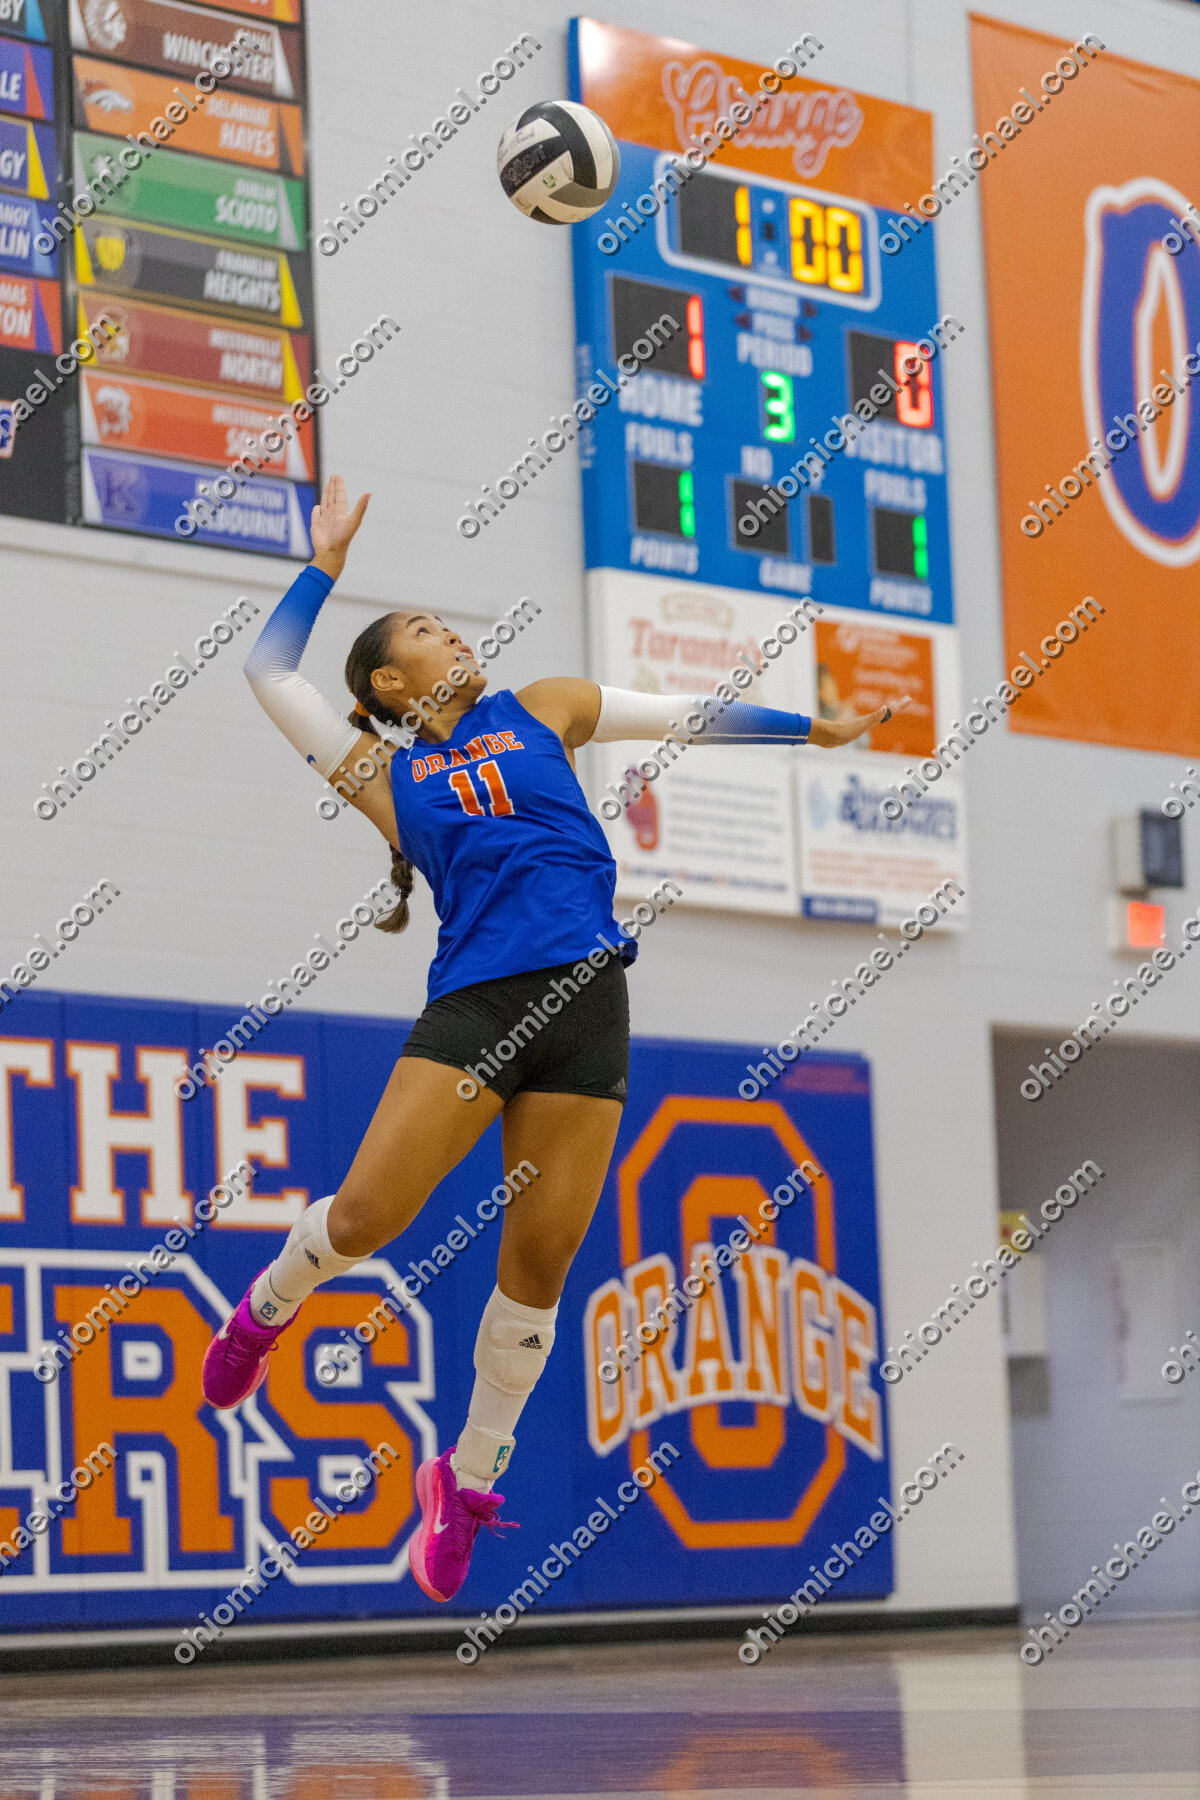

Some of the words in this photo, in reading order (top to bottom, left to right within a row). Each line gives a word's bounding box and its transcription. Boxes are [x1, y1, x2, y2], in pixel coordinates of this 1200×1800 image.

[219, 121, 275, 157] HAYES
[215, 195, 278, 233] SCIOTO
[203, 269, 281, 312] HEIGHTS
[686, 294, 705, 379] 1
[219, 352, 283, 388] NORTH
[618, 372, 703, 427] HOME
[762, 370, 795, 442] 3
[678, 469, 696, 538] 1
[630, 535, 699, 575] POINTS
[912, 515, 929, 580] 1
[411, 730, 525, 783] ORANGE
[448, 759, 515, 818] 11
[583, 1239, 885, 1461] ORANGE
